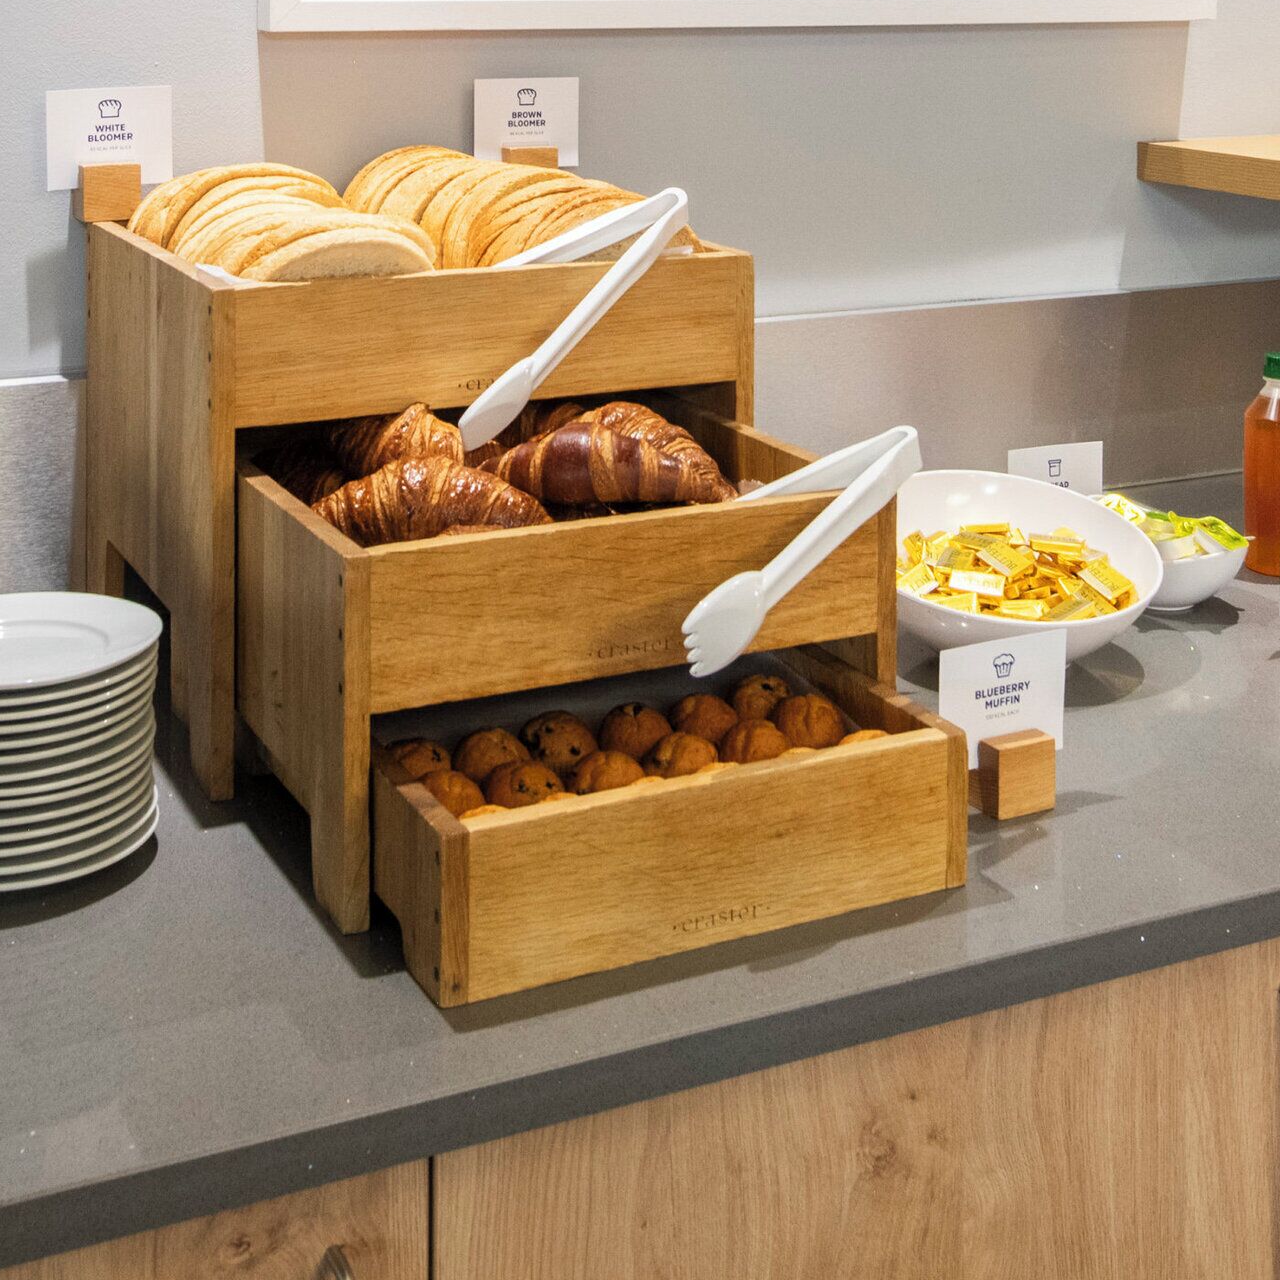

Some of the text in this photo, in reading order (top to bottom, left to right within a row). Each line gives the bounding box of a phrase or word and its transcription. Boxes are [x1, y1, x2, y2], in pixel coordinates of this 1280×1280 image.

[511, 111, 542, 119] BROWN
[95, 123, 126, 132] WHITE
[507, 119, 546, 128] BLOOMER
[87, 132, 134, 143] BLOOMER
[975, 680, 1031, 700] BLUEBERRY
[984, 694, 1021, 710] MUFFIN
